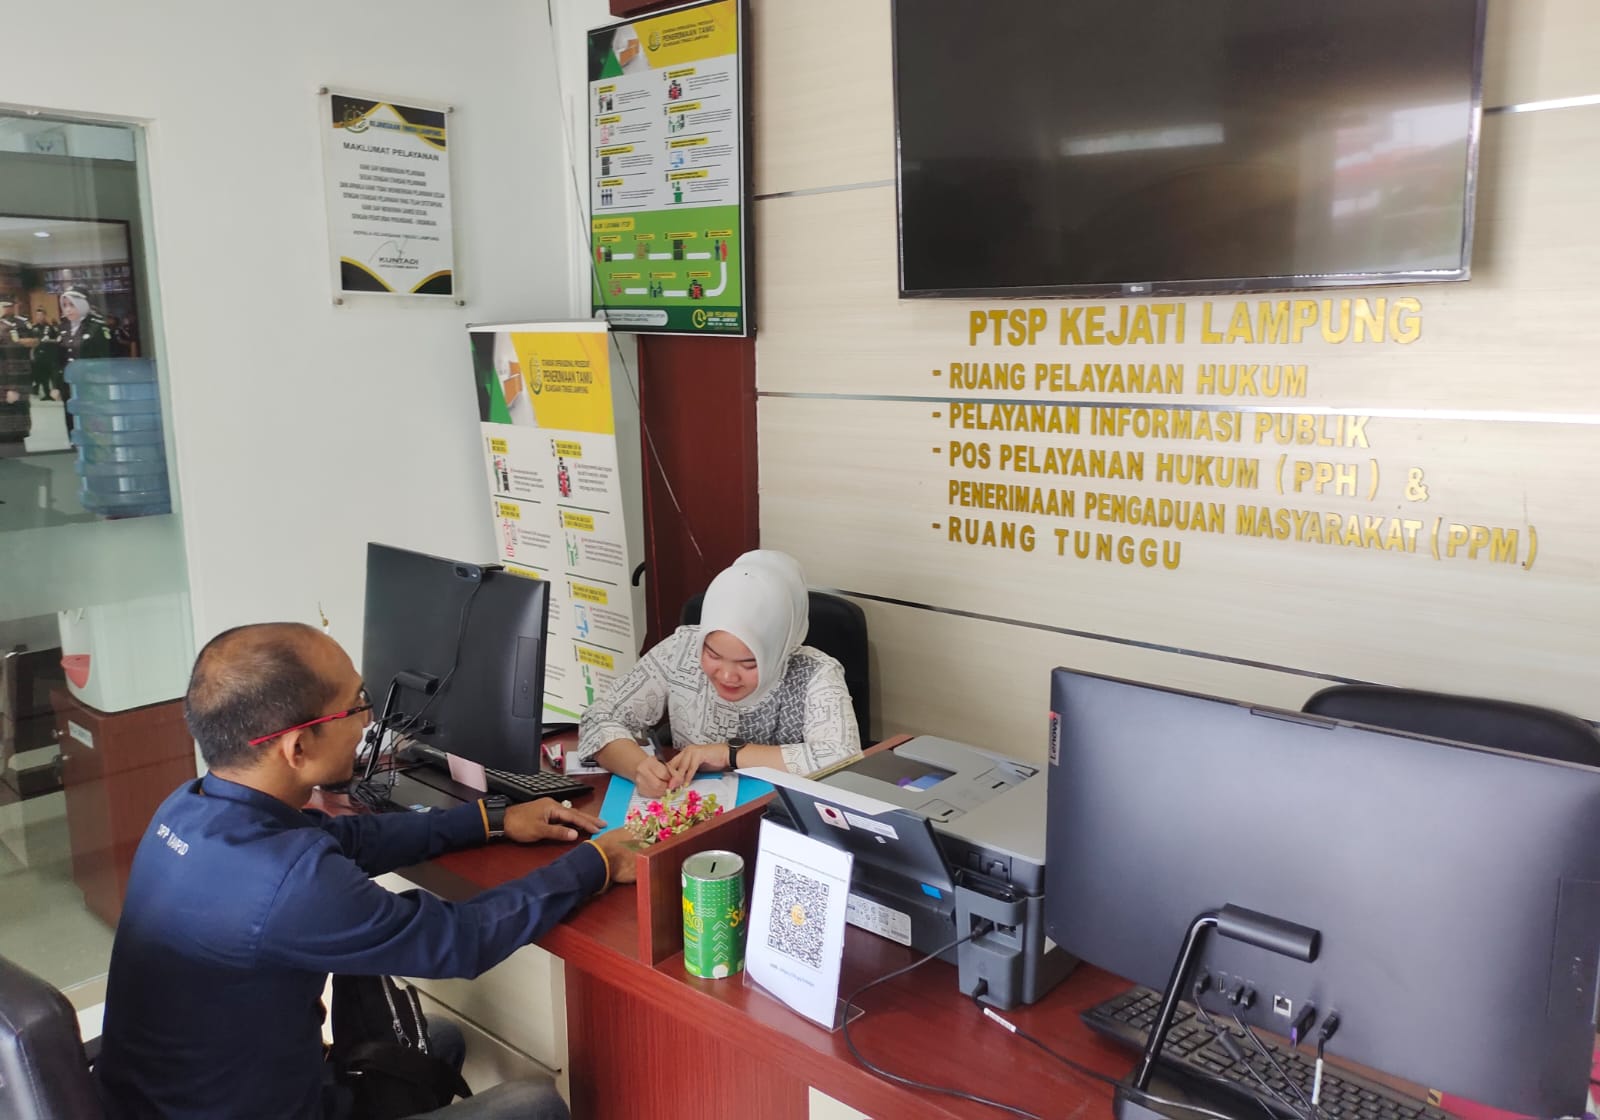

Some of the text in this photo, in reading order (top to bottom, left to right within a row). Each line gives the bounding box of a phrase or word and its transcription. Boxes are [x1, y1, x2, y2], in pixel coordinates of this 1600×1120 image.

[343, 142, 440, 162] MAKLUMAT PELAYANAN
[379, 257, 419, 265] KUNTADI
[969, 297, 1421, 346] PTSP KEJATI LAMPUNG
[949, 363, 1026, 391] RUANG
[1034, 364, 1183, 394] PELAYANAN
[1197, 364, 1307, 398] HUKUM
[949, 403, 1081, 434] PELAYANAN
[1090, 407, 1242, 442] INFORMASI
[1254, 413, 1371, 448] PUBLIK
[949, 441, 991, 469] POS
[999, 444, 1145, 481] PELAYANAN
[1156, 455, 1259, 489] HUKUM
[1405, 467, 1429, 502] &
[949, 479, 1075, 519] PENERIMAAN
[1084, 492, 1225, 534] PENGADUAN
[1236, 505, 1423, 553] MASYARAKAT
[948, 517, 1036, 552] RUANG
[1055, 529, 1182, 570] TUNGGU
[1050, 715, 1059, 760] Lenovo
